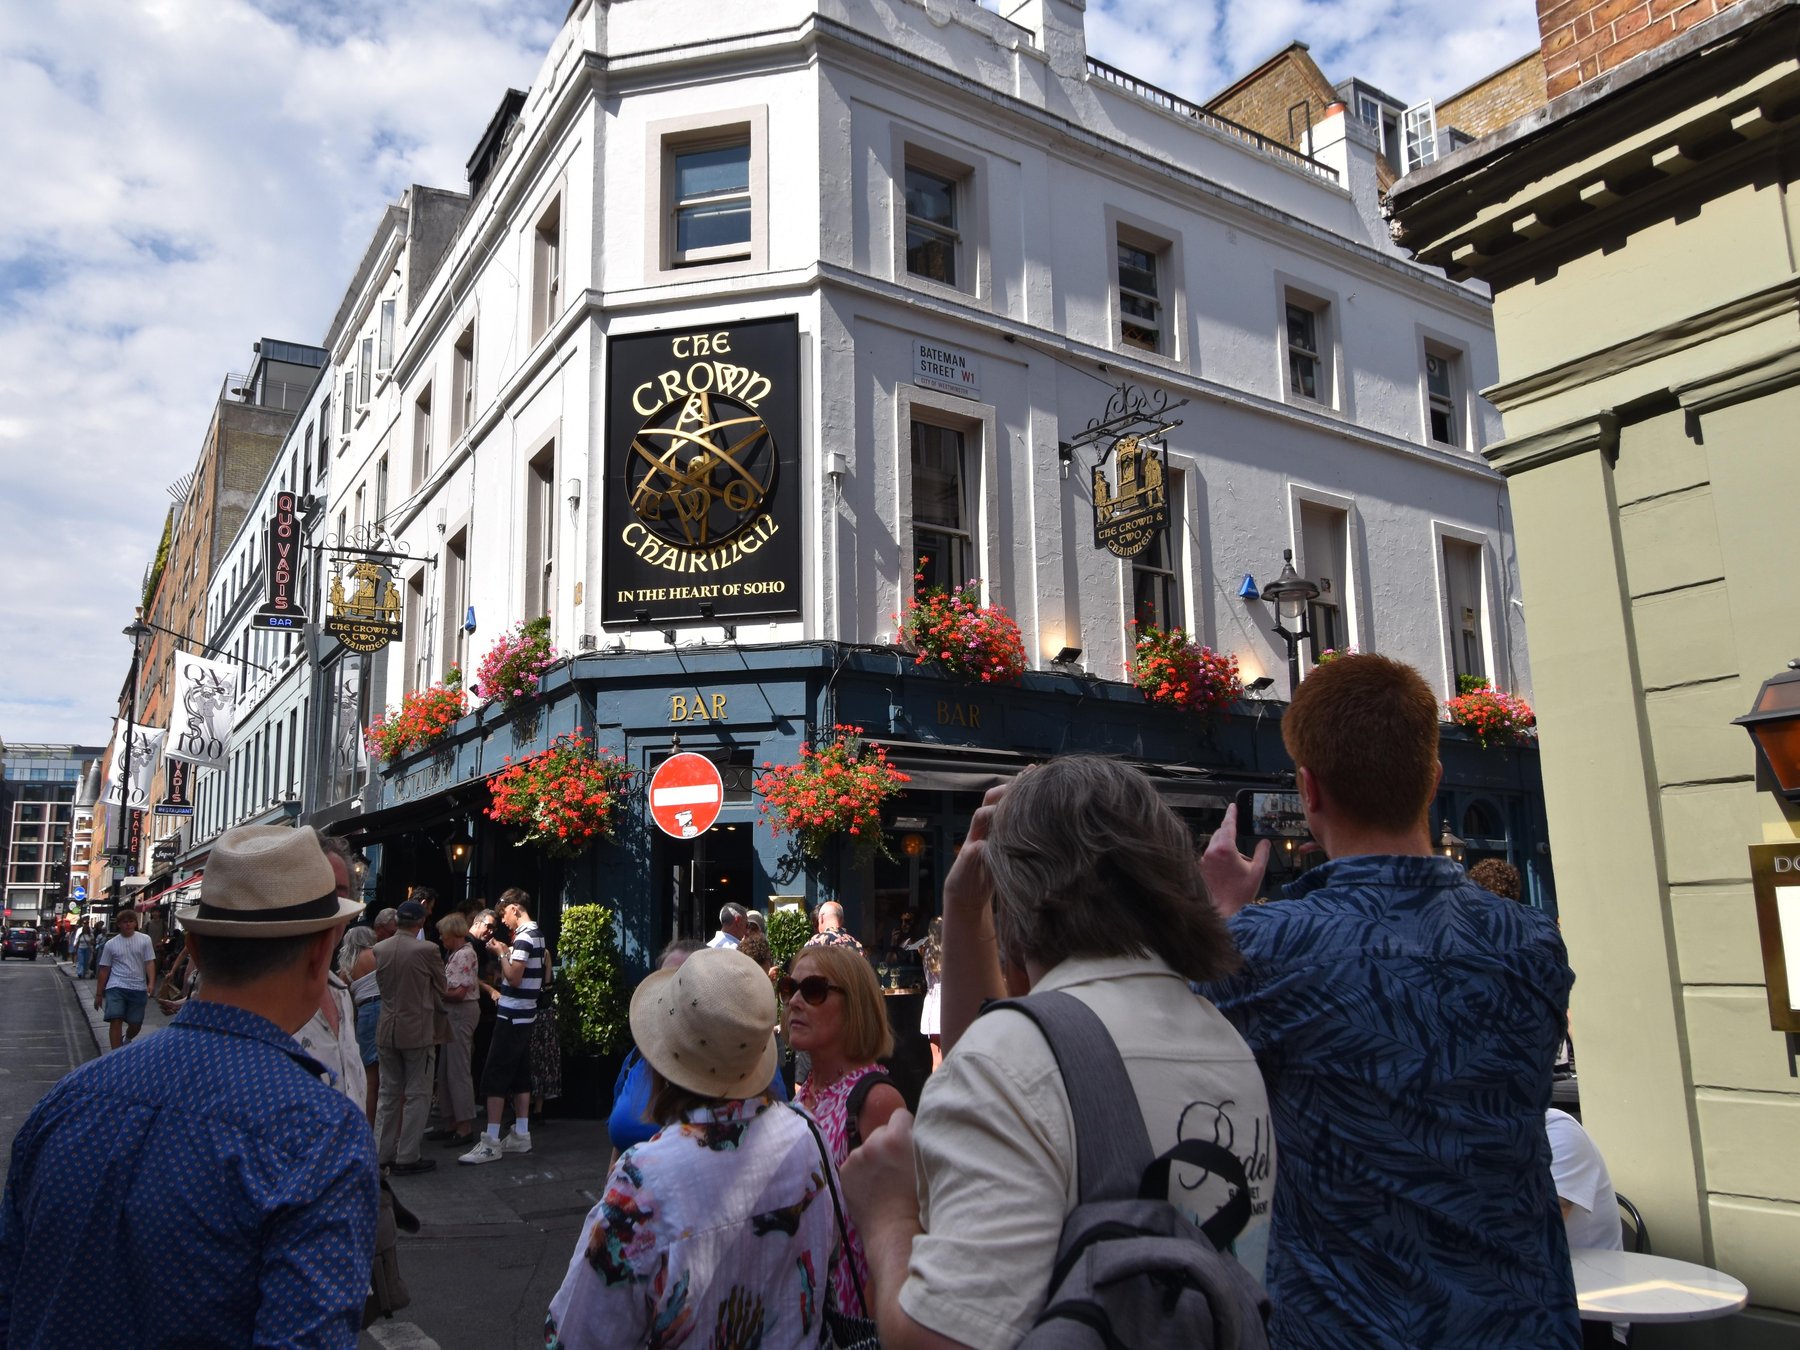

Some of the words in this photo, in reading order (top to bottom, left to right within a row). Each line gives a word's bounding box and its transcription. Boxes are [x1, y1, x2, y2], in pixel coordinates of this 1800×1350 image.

[672, 331, 732, 359] THE
[920, 345, 966, 369] BATEMAN
[920, 360, 955, 379] STREET
[961, 370, 975, 385] W1
[632, 360, 772, 416] CROWN
[681, 398, 705, 423] &
[636, 479, 755, 521] TWO
[277, 495, 293, 538] QUO
[1098, 526, 1118, 540] THE
[1118, 514, 1154, 533] CROWN
[1156, 512, 1164, 521] &
[621, 512, 780, 574] CHAIRMEN
[1107, 528, 1155, 556] CHAIRMEN
[1118, 530, 1142, 544] TWO
[274, 542, 291, 610] VADIS
[617, 590, 635, 603] IN
[636, 588, 667, 602] THE
[669, 584, 720, 600] HEART
[722, 583, 742, 596] OF
[743, 580, 785, 595] SOHO
[269, 617, 293, 627] BAR
[330, 622, 351, 631] THE
[352, 624, 389, 635] CROWN
[391, 628, 399, 636] &
[339, 632, 389, 651] CHAIRMEN
[351, 633, 376, 642] TWO
[183, 663, 231, 687] QV
[671, 694, 729, 722] BAR
[936, 699, 982, 729] BAR
[177, 731, 223, 760] 100
[171, 760, 184, 803] VADIS
[157, 806, 193, 815] RESTAURANT
